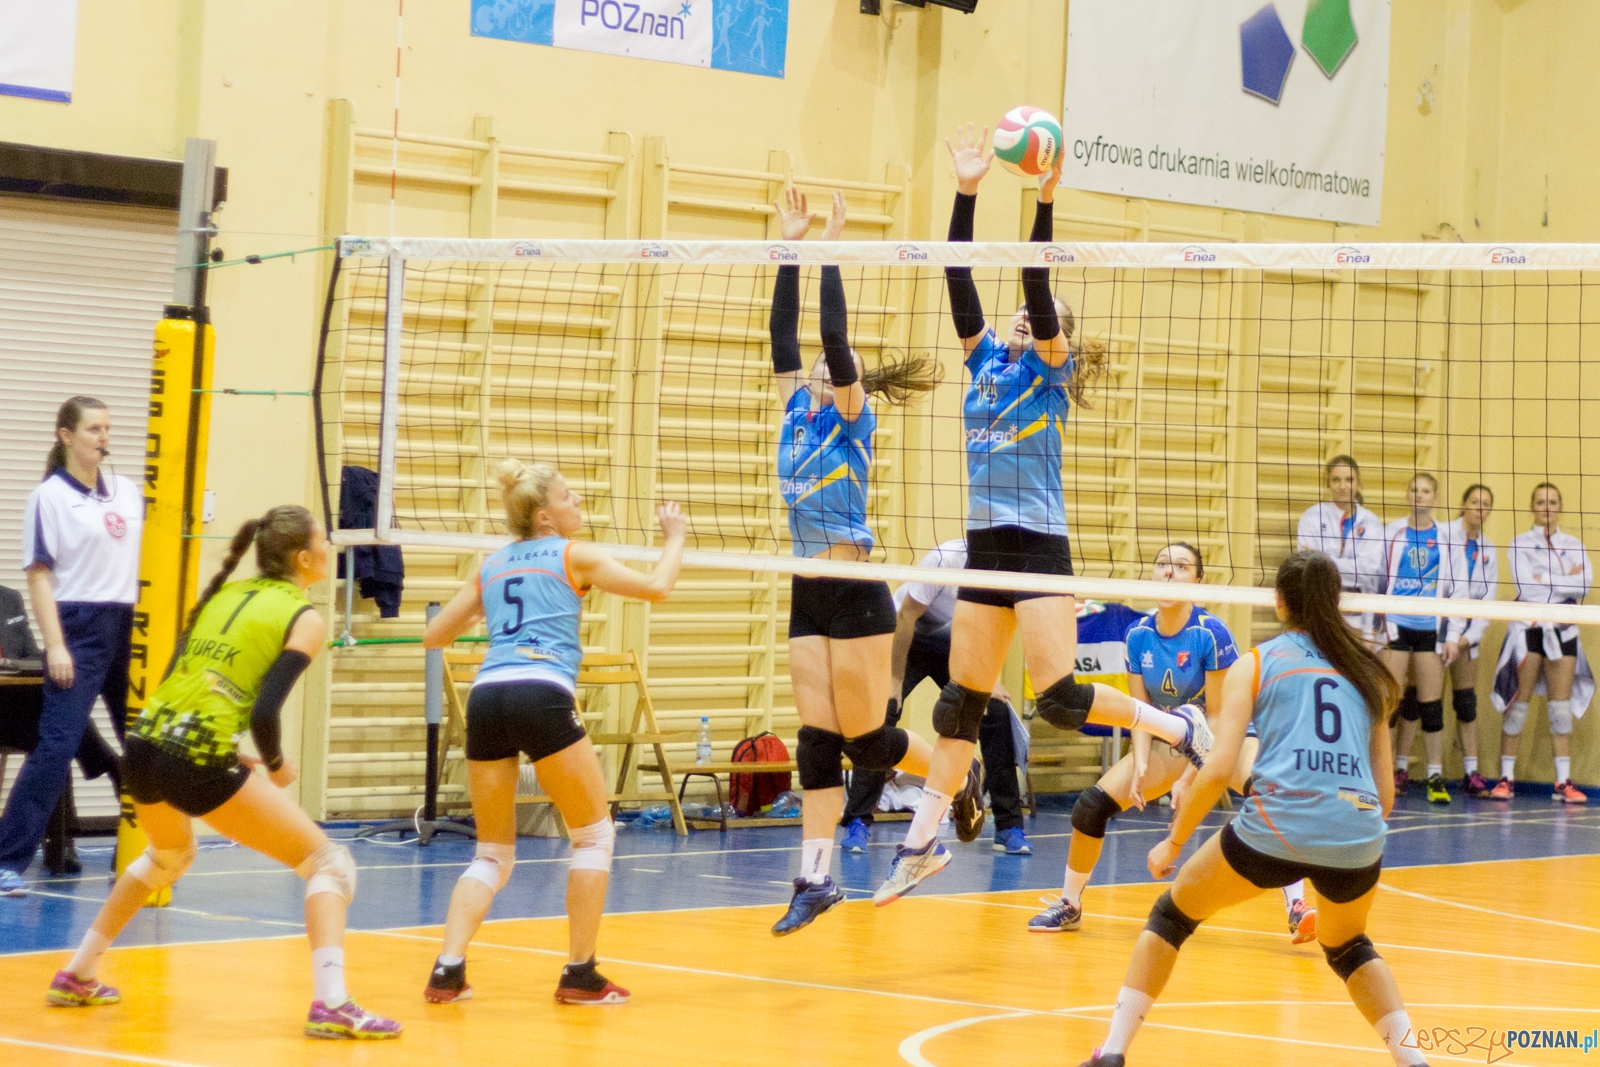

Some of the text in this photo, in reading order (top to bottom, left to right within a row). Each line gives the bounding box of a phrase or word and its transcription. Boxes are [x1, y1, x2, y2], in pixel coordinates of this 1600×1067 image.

[1041, 137, 1052, 166] molten
[1073, 136, 1142, 167] cyfrowa
[1148, 144, 1229, 179] drukarnia
[1235, 158, 1371, 198] wielkoformatowa
[515, 247, 541, 256] Enea
[641, 248, 669, 258] Enea
[769, 250, 798, 260] Enea
[899, 251, 928, 260] Enea
[1044, 252, 1075, 262] Enea
[1184, 251, 1216, 262] Enea
[1336, 252, 1370, 263] Enea
[1491, 253, 1526, 264] Enea
[507, 550, 559, 563] ALEXAS
[502, 576, 525, 635] 5
[220, 589, 261, 636] 1
[185, 638, 242, 668] TUREK
[1161, 668, 1178, 697] 4
[1313, 677, 1342, 744] 6
[1293, 748, 1363, 779] TUREK
